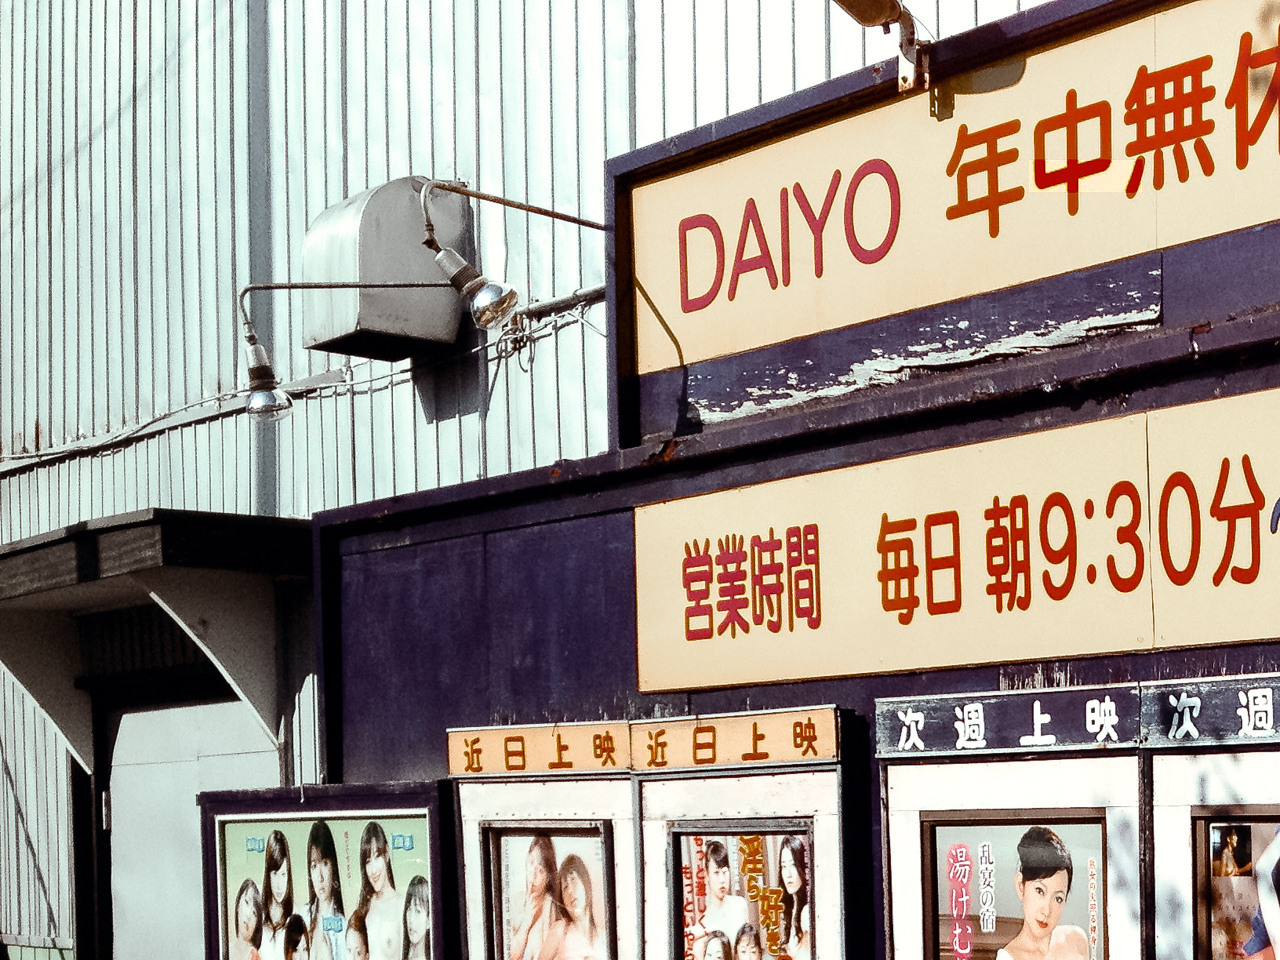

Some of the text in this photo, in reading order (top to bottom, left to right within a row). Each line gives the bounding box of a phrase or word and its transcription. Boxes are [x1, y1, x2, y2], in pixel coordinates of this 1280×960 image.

[678, 157, 902, 314] DAIYO
[681, 522, 823, 642] 営業時間
[876, 509, 963, 626] 毎日
[463, 730, 616, 773] 近日上映
[646, 717, 818, 768] 近日上映
[896, 696, 1120, 752] 次週上映
[978, 842, 997, 933] 乱宴の宿
